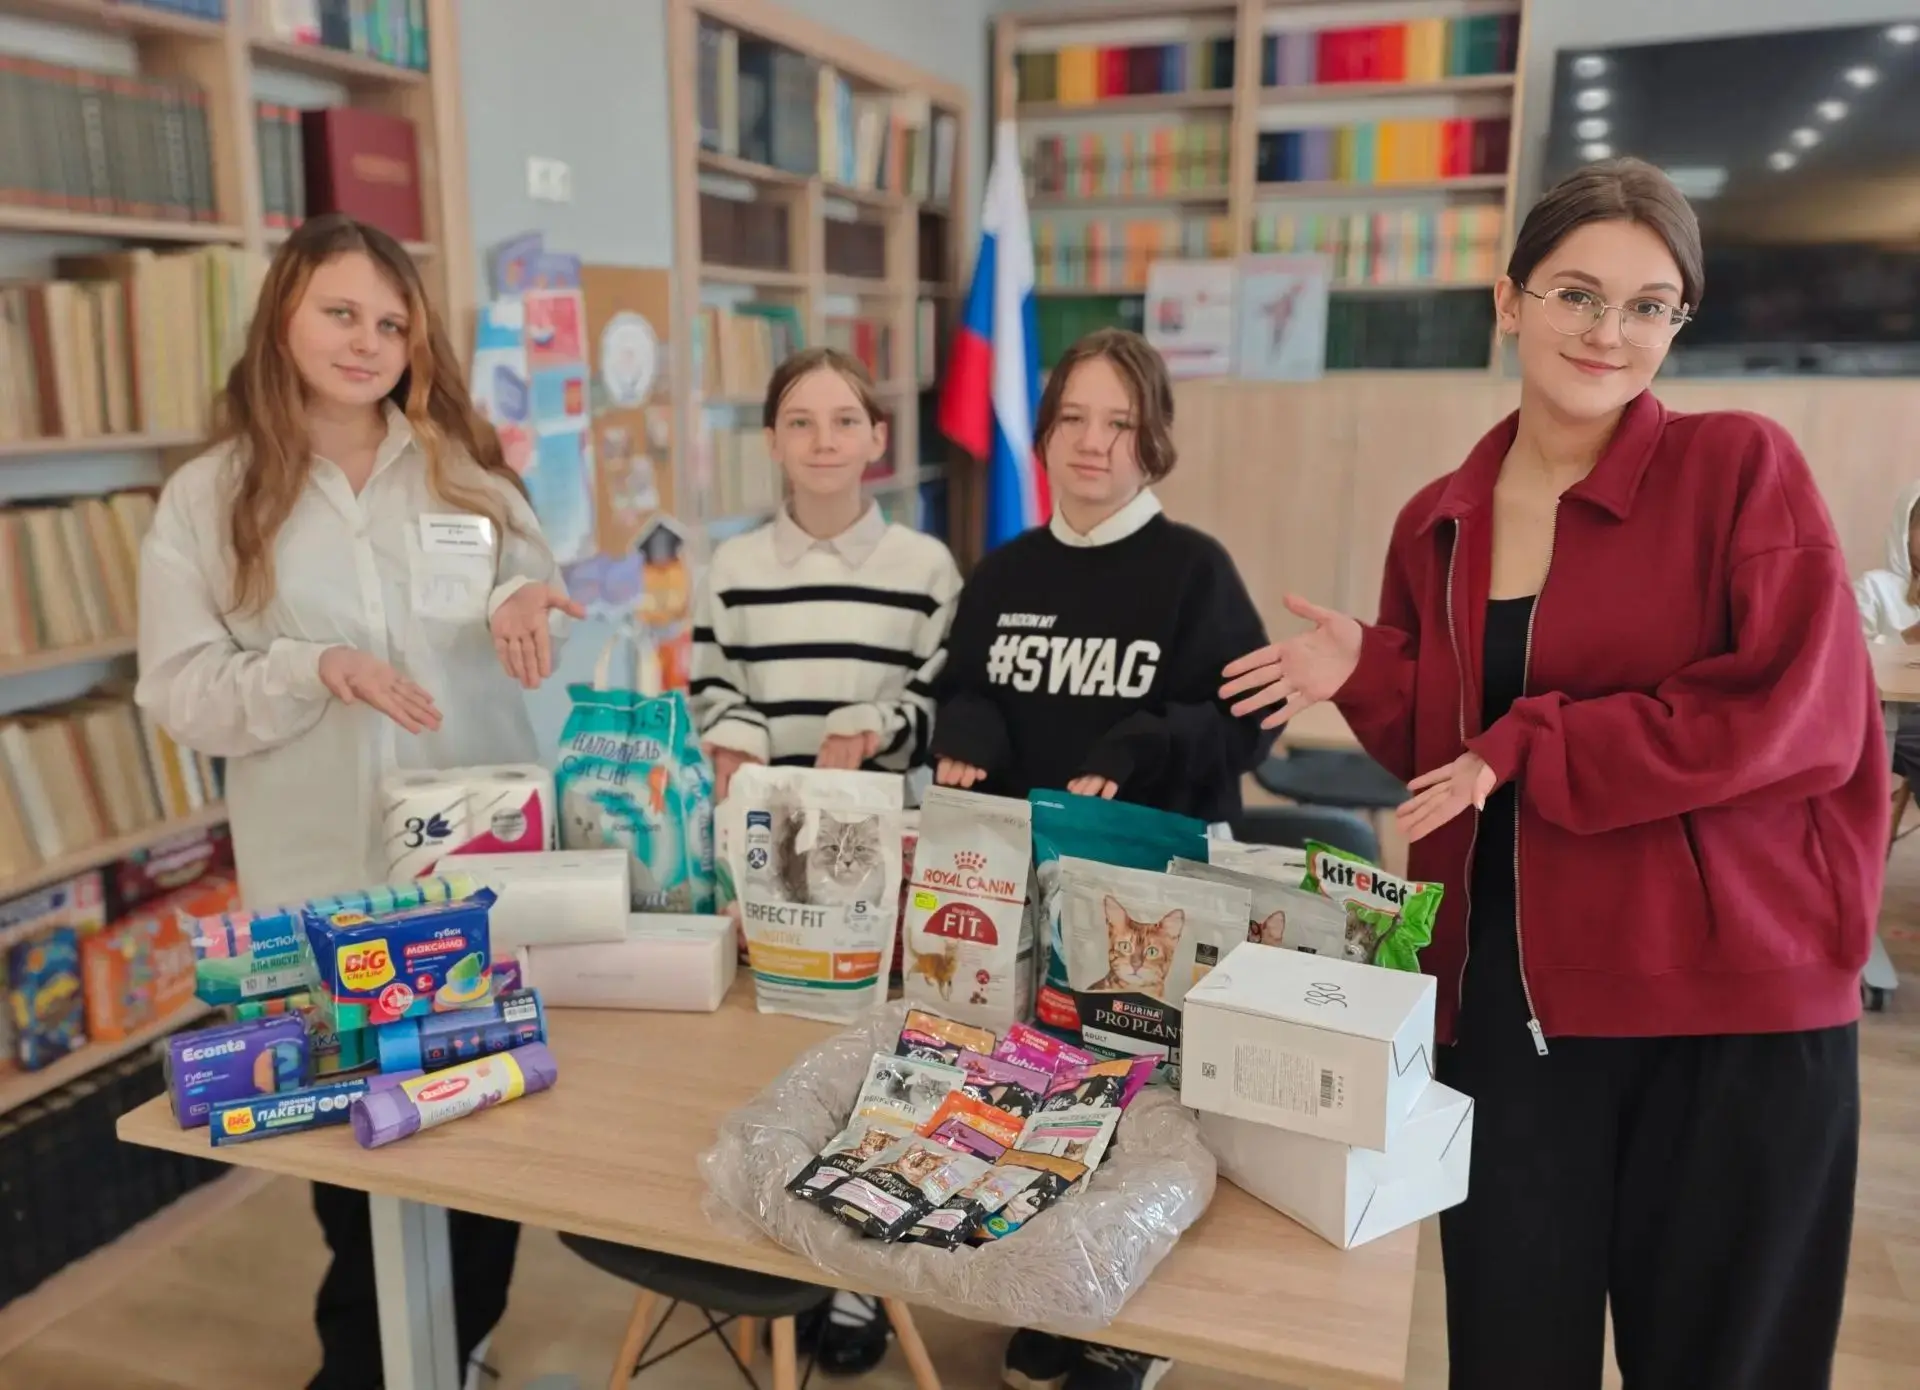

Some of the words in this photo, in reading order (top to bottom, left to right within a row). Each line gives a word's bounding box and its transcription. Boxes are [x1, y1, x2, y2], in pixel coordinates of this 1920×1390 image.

[986, 634, 1161, 698] #SWAG
[404, 817, 424, 848] 3
[923, 868, 963, 888] ROYAL
[966, 876, 1016, 896] CANIN
[1322, 858, 1408, 907] kitekat
[745, 902, 798, 926] ERFECT
[854, 900, 867, 914] 5
[434, 928, 462, 939] губки
[943, 913, 982, 937] FIT
[406, 939, 464, 956] максима
[1124, 1004, 1160, 1018] PURINA
[1095, 1008, 1130, 1028] PRO
[1132, 1018, 1178, 1040] PLAN
[1084, 1031, 1107, 1043] ADULT
[182, 1039, 246, 1062] Econta
[257, 1102, 316, 1122] ПАКЕТЫ
